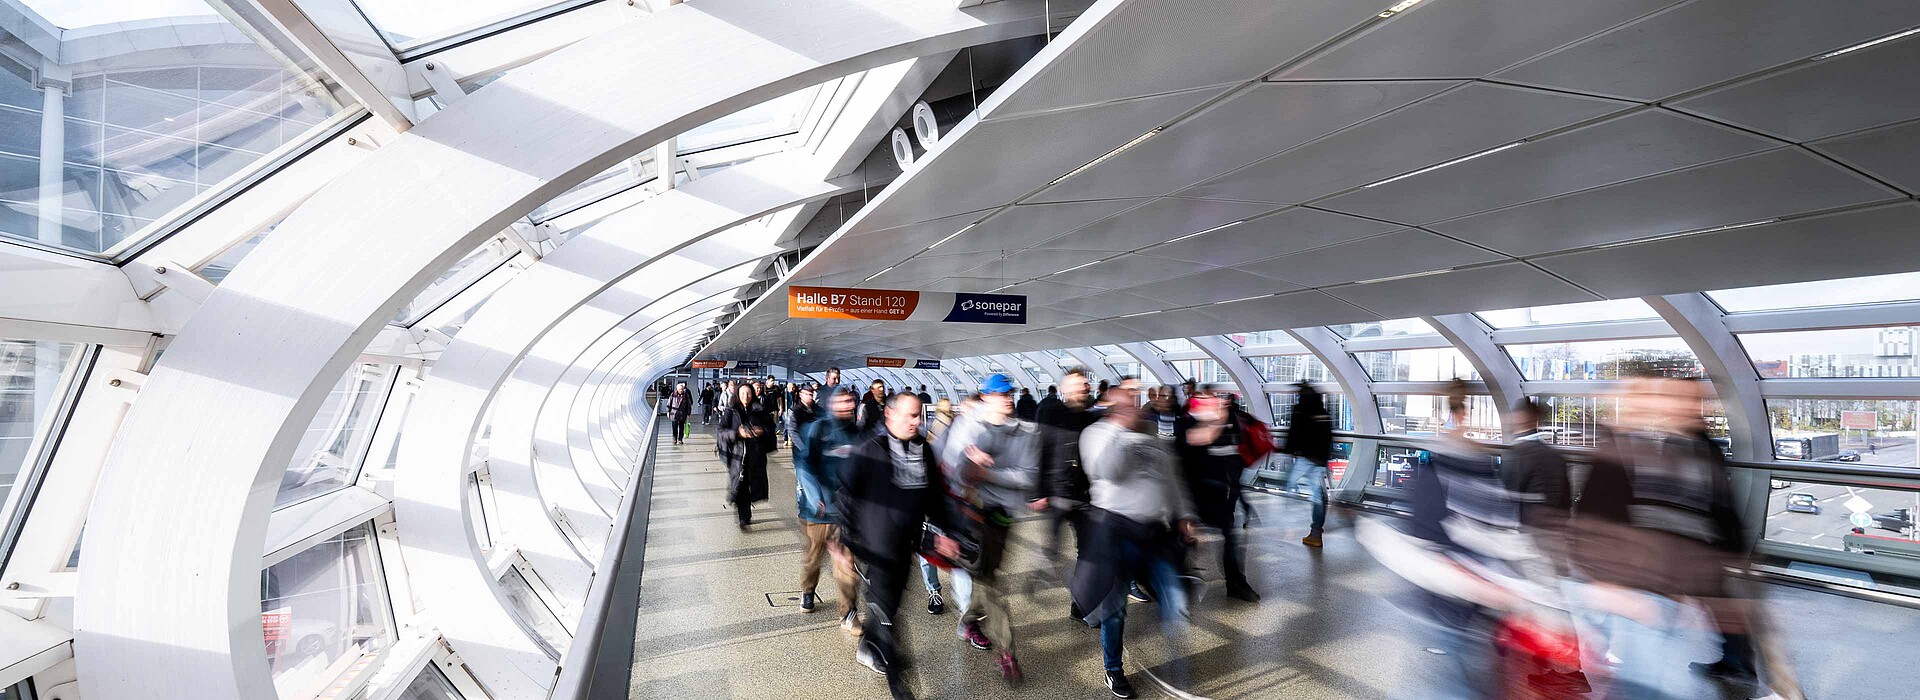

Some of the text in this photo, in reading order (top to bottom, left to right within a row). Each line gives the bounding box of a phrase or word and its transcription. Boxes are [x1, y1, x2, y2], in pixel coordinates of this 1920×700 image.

[797, 292, 906, 307] Halle B7 Stand 120
[975, 302, 1021, 312] sonepar
